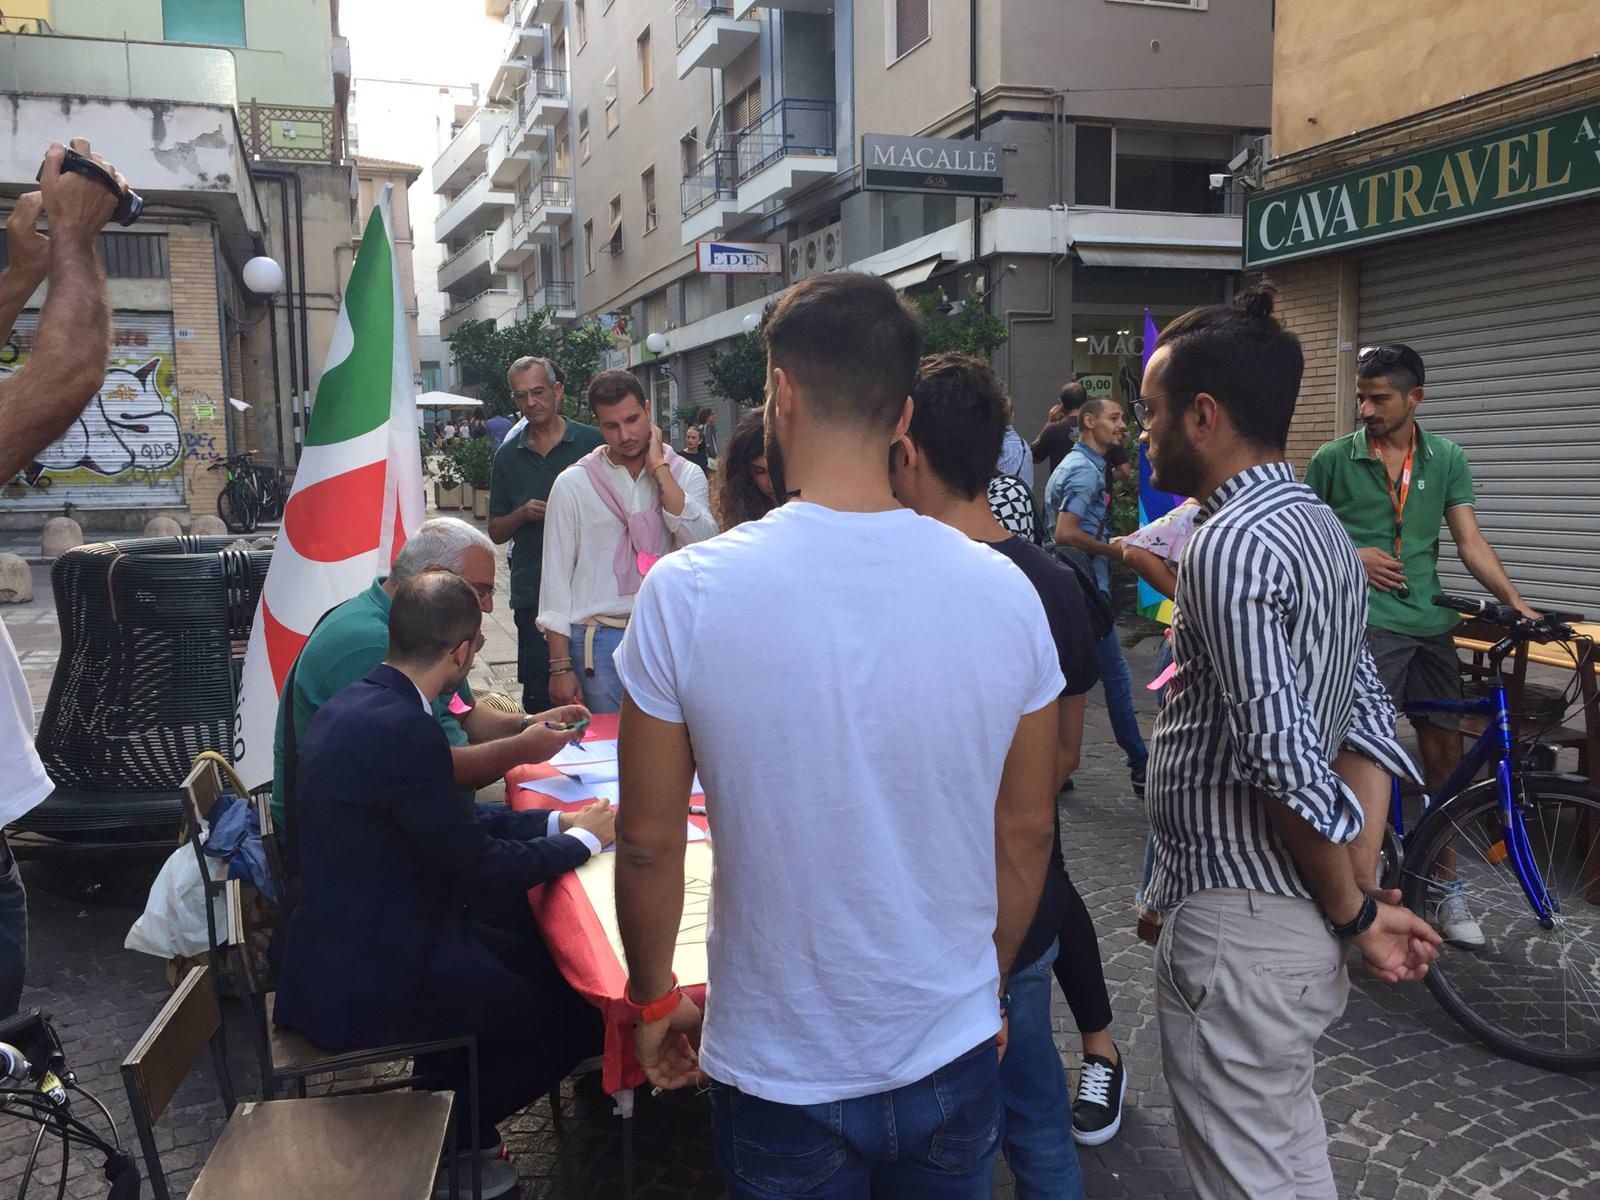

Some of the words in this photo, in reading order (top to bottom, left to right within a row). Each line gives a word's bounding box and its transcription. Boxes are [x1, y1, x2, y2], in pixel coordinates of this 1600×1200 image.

[872, 144, 997, 172] MACALLÉ
[709, 243, 769, 266] EDEN
[1088, 335, 1144, 358] MAC
